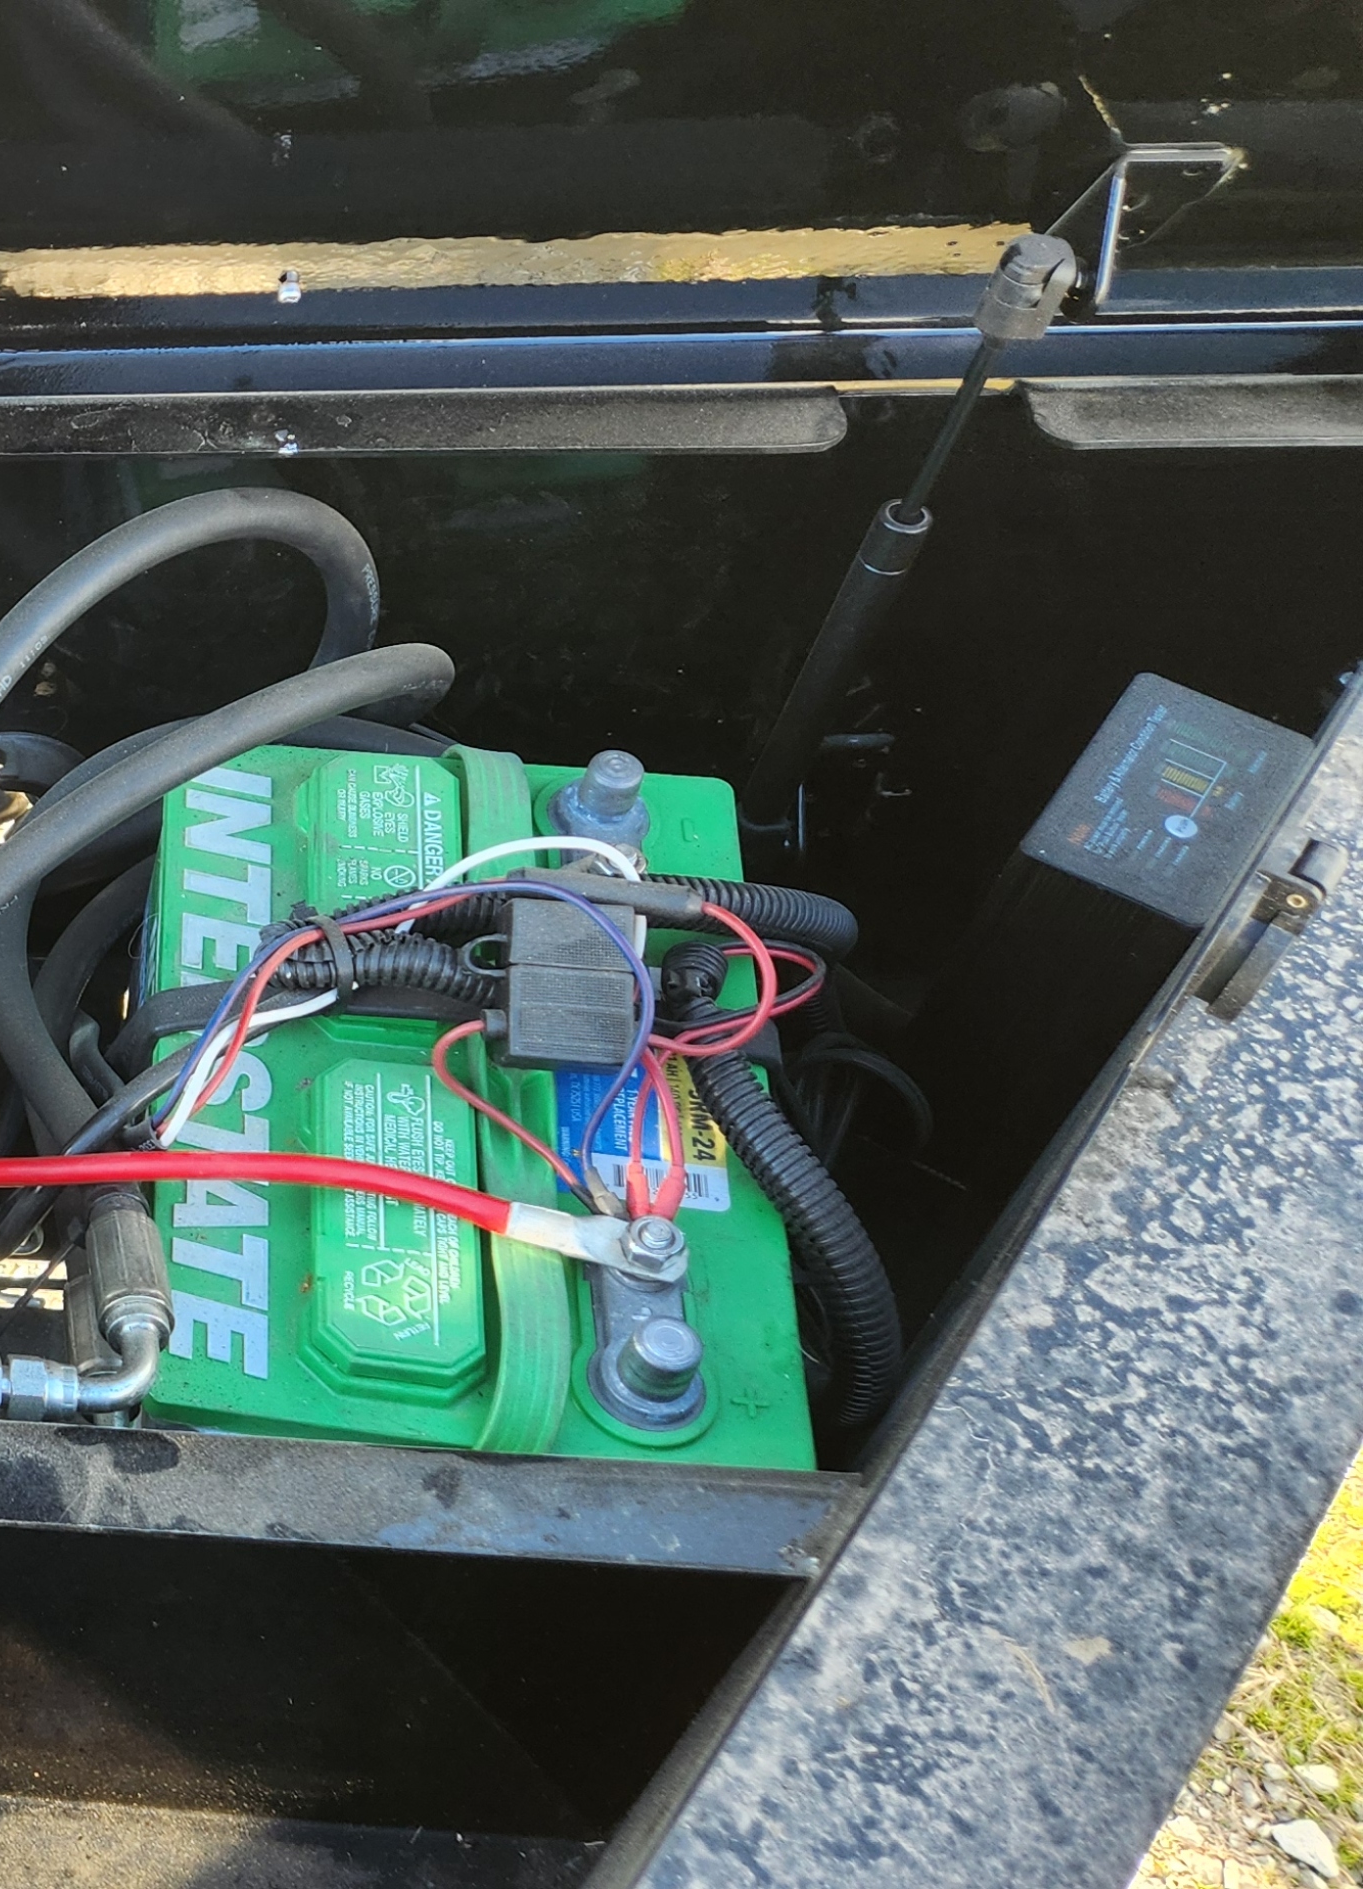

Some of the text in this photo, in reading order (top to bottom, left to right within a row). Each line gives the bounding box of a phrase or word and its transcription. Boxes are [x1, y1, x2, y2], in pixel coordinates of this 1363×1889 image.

[1093, 781, 1121, 804] Battery
[1111, 748, 1140, 777] Alternator
[1129, 722, 1158, 751] Condition
[1146, 703, 1168, 723] Tester
[359, 790, 372, 820] GASES
[372, 790, 384, 838] EXPLOSIVE
[384, 811, 396, 835] EYES
[396, 812, 410, 844] SHIELD
[423, 809, 445, 877] DANGER
[370, 866, 383, 881] NO
[666, 1062, 679, 1081] AH
[343, 1089, 354, 1105] NOT
[354, 1083, 365, 1135] INSTRUCTIONS
[365, 1117, 375, 1134] FOR
[383, 1114, 398, 1154] MEDICAL
[397, 1116, 411, 1140] WITH
[410, 1116, 426, 1173] FLUSH EYES
[433, 1134, 444, 1152] NOT
[445, 1138, 456, 1178] KEEP OUT
[366, 1211, 378, 1242] FOLLOW
[343, 1270, 355, 1311] RECYCLE
